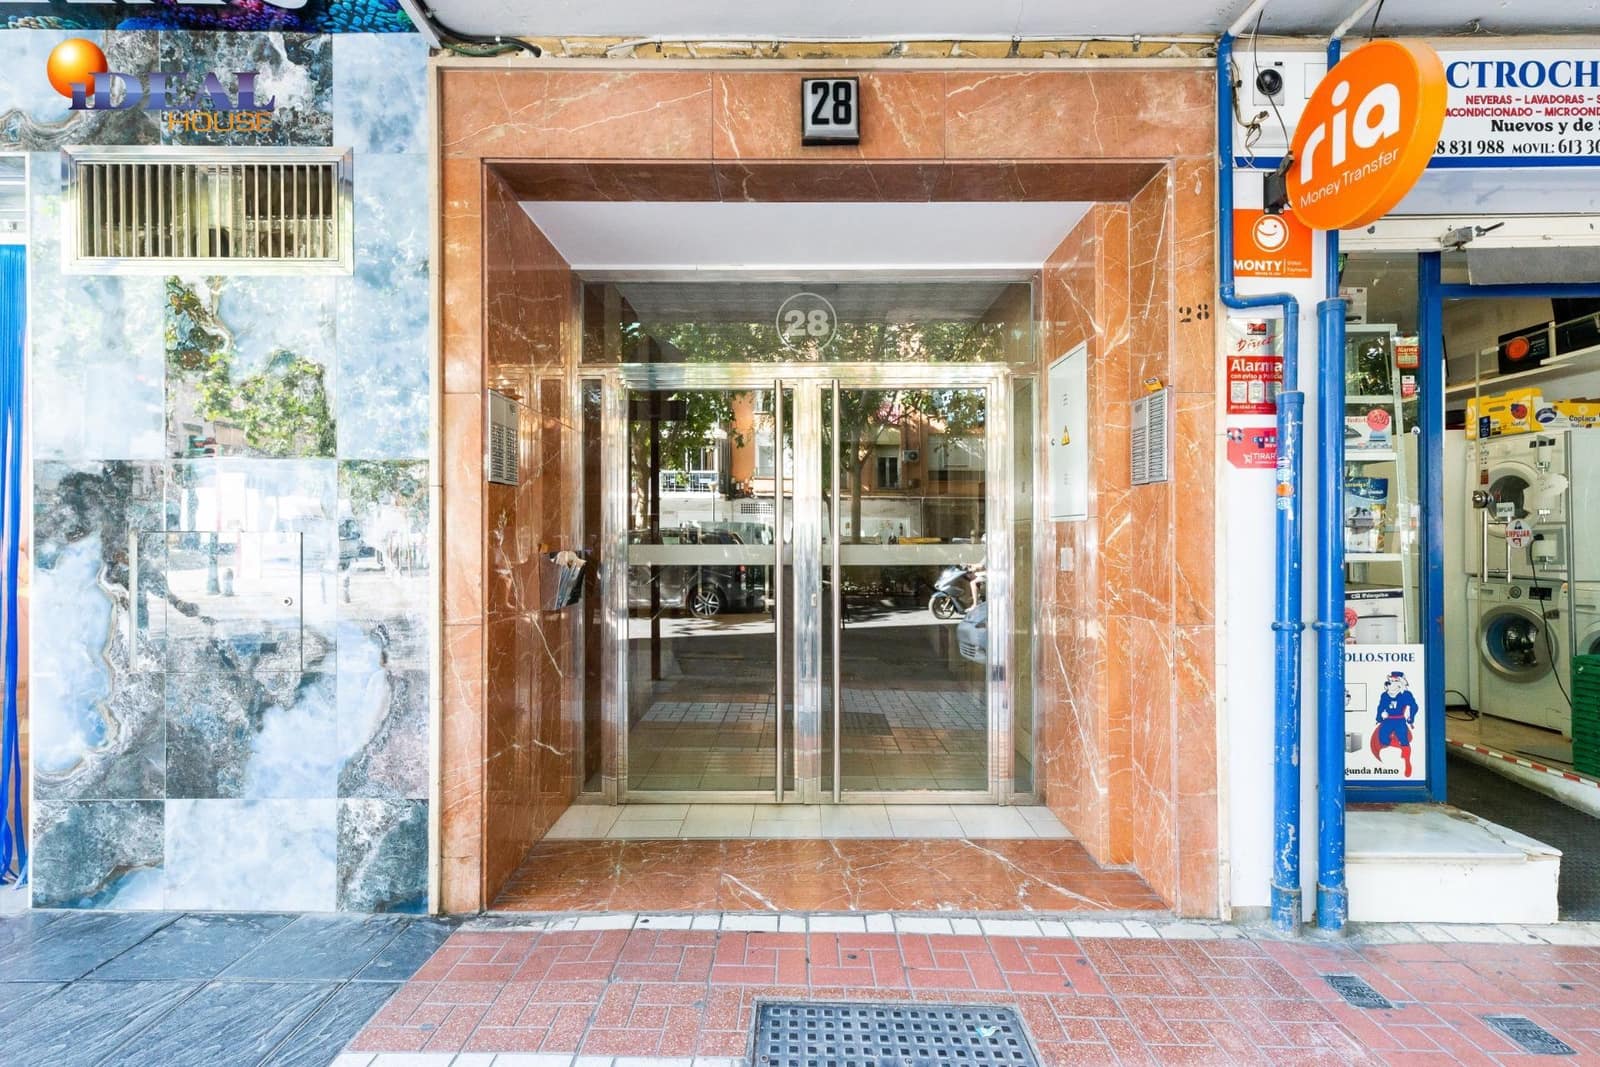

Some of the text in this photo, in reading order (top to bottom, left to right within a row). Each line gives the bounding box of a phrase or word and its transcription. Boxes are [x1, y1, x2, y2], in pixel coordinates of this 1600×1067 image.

[1446, 60, 1600, 88] CTROCH
[811, 81, 851, 125] 28
[1466, 95, 1512, 105] NEVERAS
[1525, 95, 1585, 105] LAVADORAS
[1445, 107, 1533, 117] ACONDICIONADO
[1300, 80, 1401, 185] ria
[1491, 119, 1553, 132] Nuevos
[1559, 121, 1568, 135] y
[1573, 118, 1593, 132] de
[1450, 140, 1472, 155] 831
[1477, 140, 1504, 155] 988
[1558, 139, 1582, 154] 613
[1300, 147, 1399, 208] Money Transfer
[1234, 259, 1282, 271] MONTY
[1179, 303, 1210, 323] 28
[784, 309, 829, 336] 28
[1231, 359, 1283, 372] Alarma
[1345, 652, 1416, 663] OLLO.STORE
[1374, 767, 1400, 775] Mano
